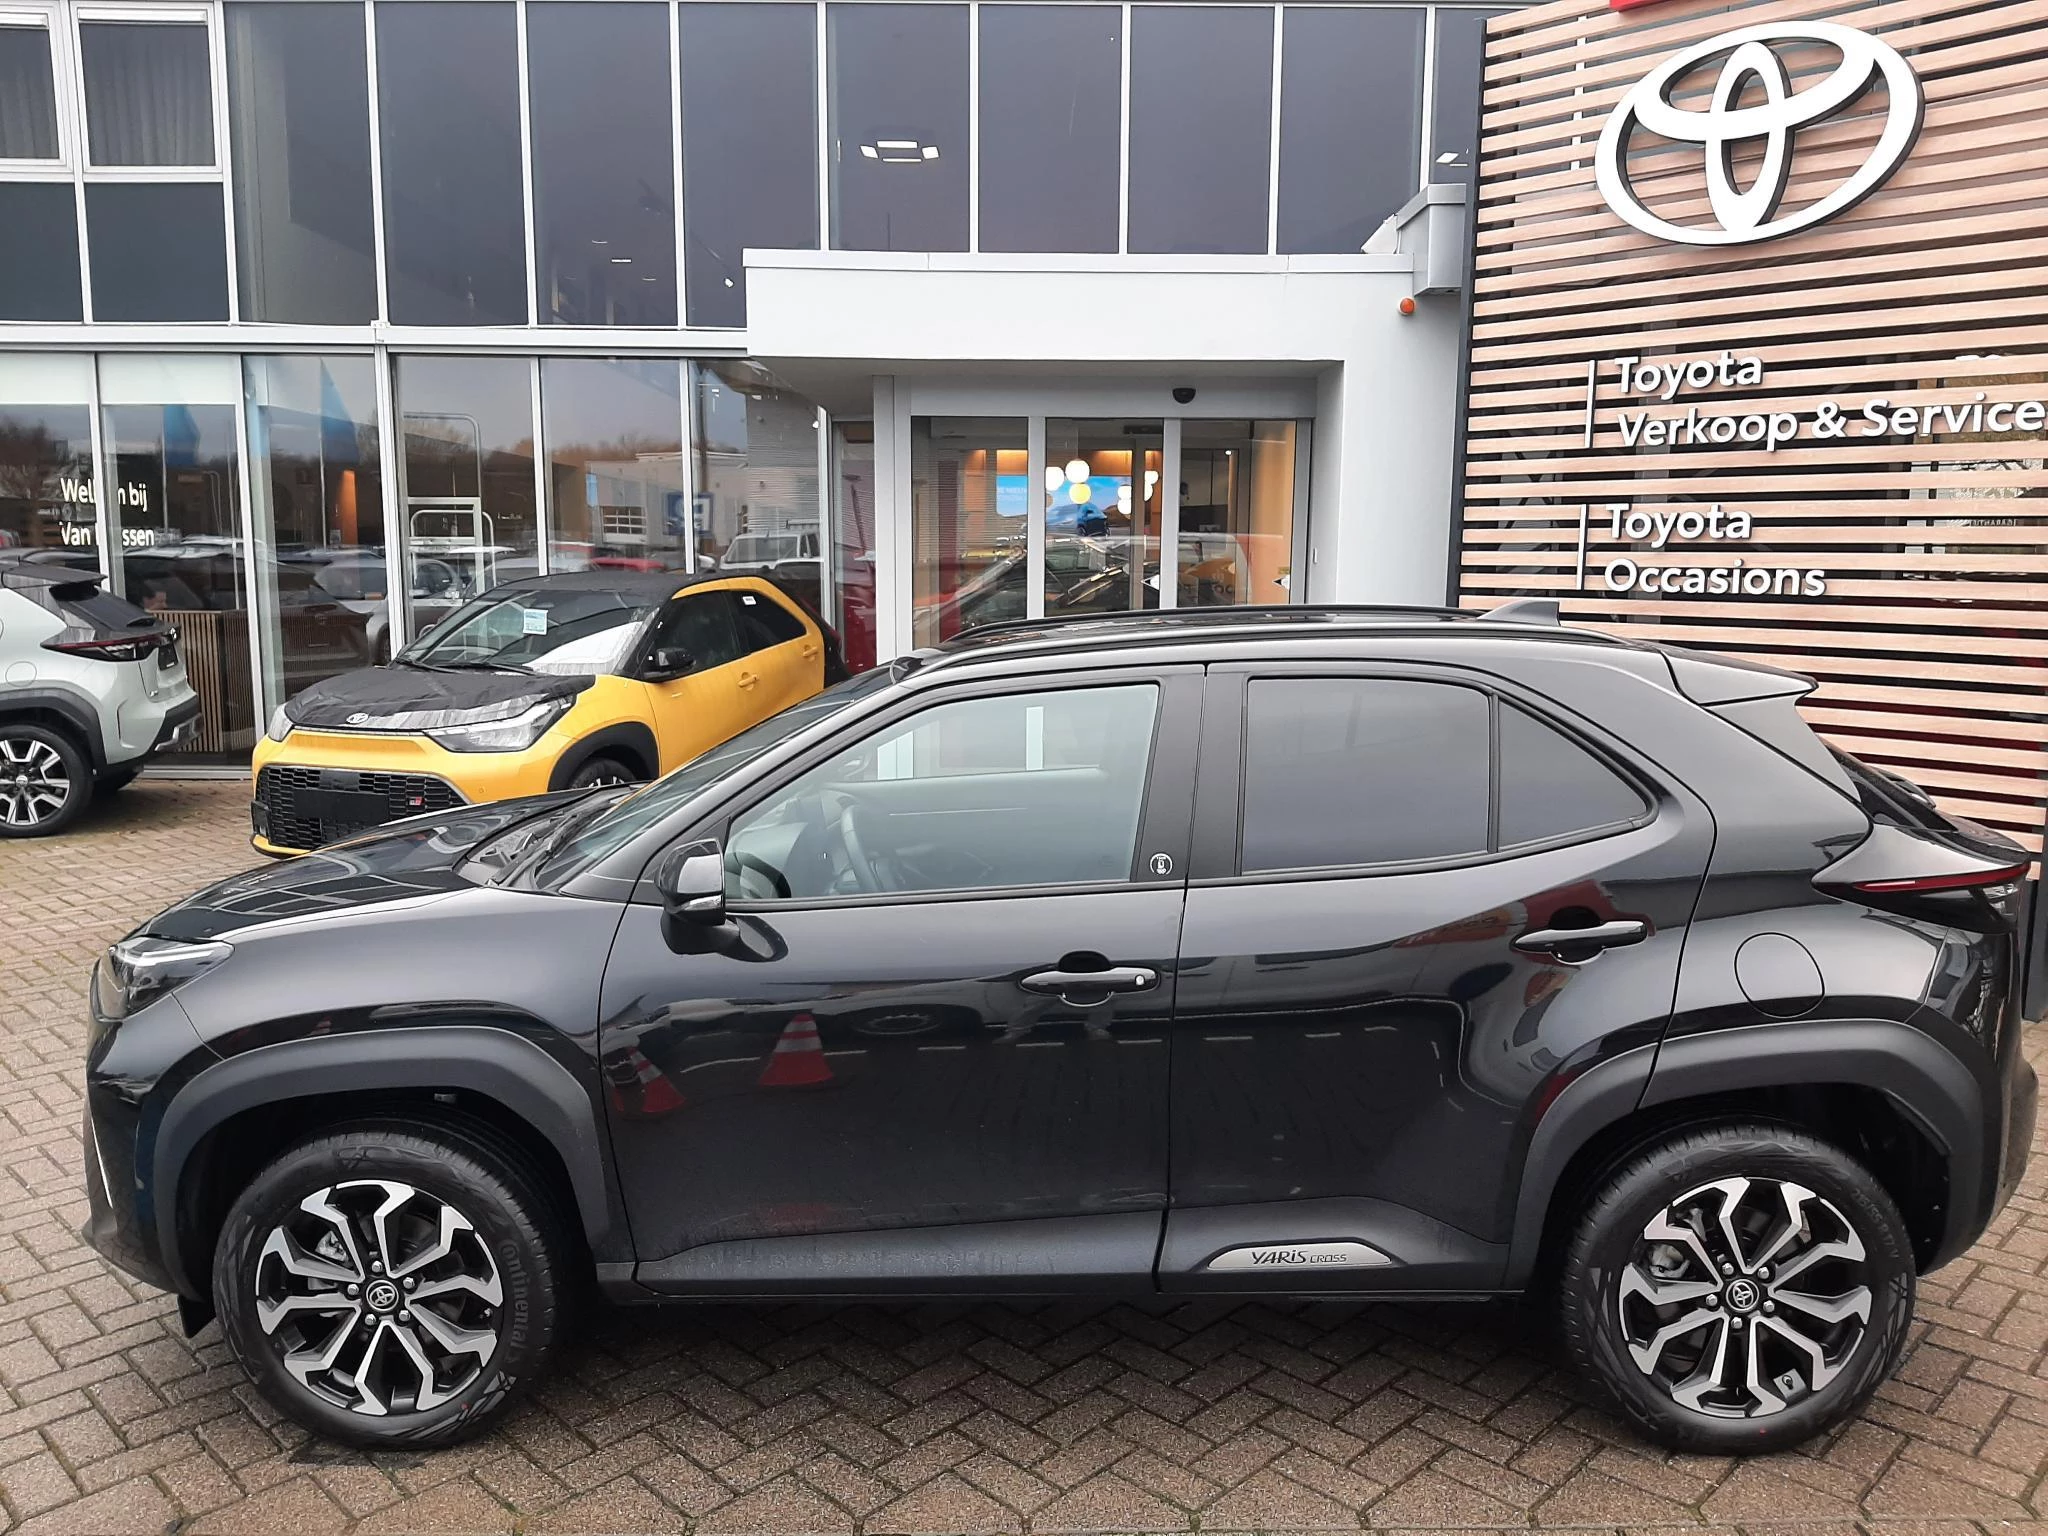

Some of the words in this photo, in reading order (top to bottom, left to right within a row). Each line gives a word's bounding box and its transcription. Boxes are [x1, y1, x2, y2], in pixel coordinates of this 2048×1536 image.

[1614, 350, 1762, 400] Toyota
[1617, 407, 1798, 451] Verkoop
[1811, 400, 1848, 438] &
[1861, 392, 2046, 436] Service
[128, 481, 148, 512] bij
[58, 520, 91, 546] Van
[1604, 502, 1752, 549] Toyota
[1604, 559, 1827, 596] Occasions
[1309, 1253, 1347, 1264] CROSS
